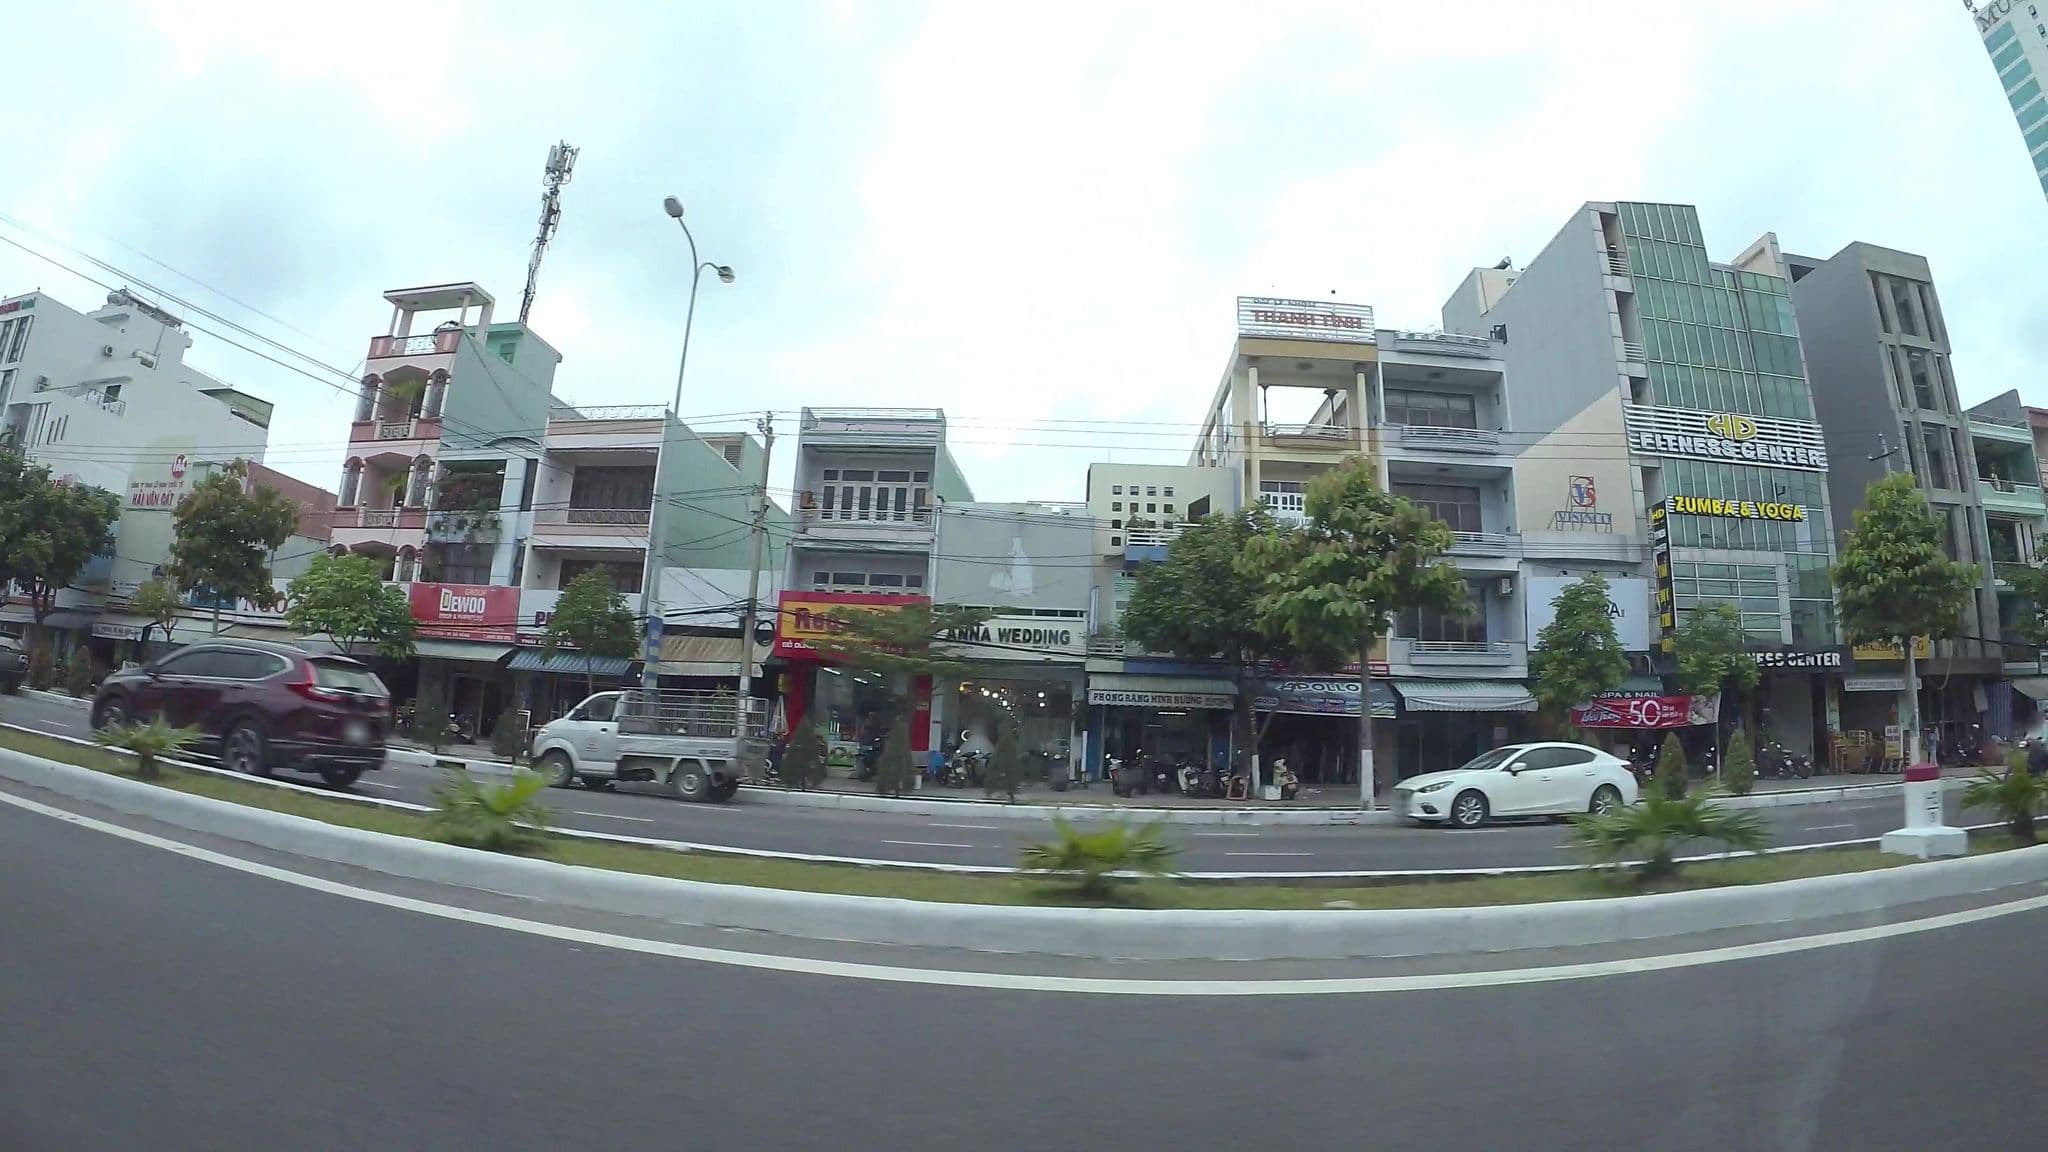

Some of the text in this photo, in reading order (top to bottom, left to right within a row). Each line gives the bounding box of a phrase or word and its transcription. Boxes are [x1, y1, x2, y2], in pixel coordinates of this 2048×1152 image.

[1707, 414, 1757, 441] HD
[1639, 431, 1828, 466] FITNESS CENTER
[1674, 496, 1804, 520] ZUMBA & YOGA
[945, 627, 1070, 645] ANNA WEDDING
[1787, 652, 1841, 667] CENTER
[1629, 700, 1661, 725] 50
